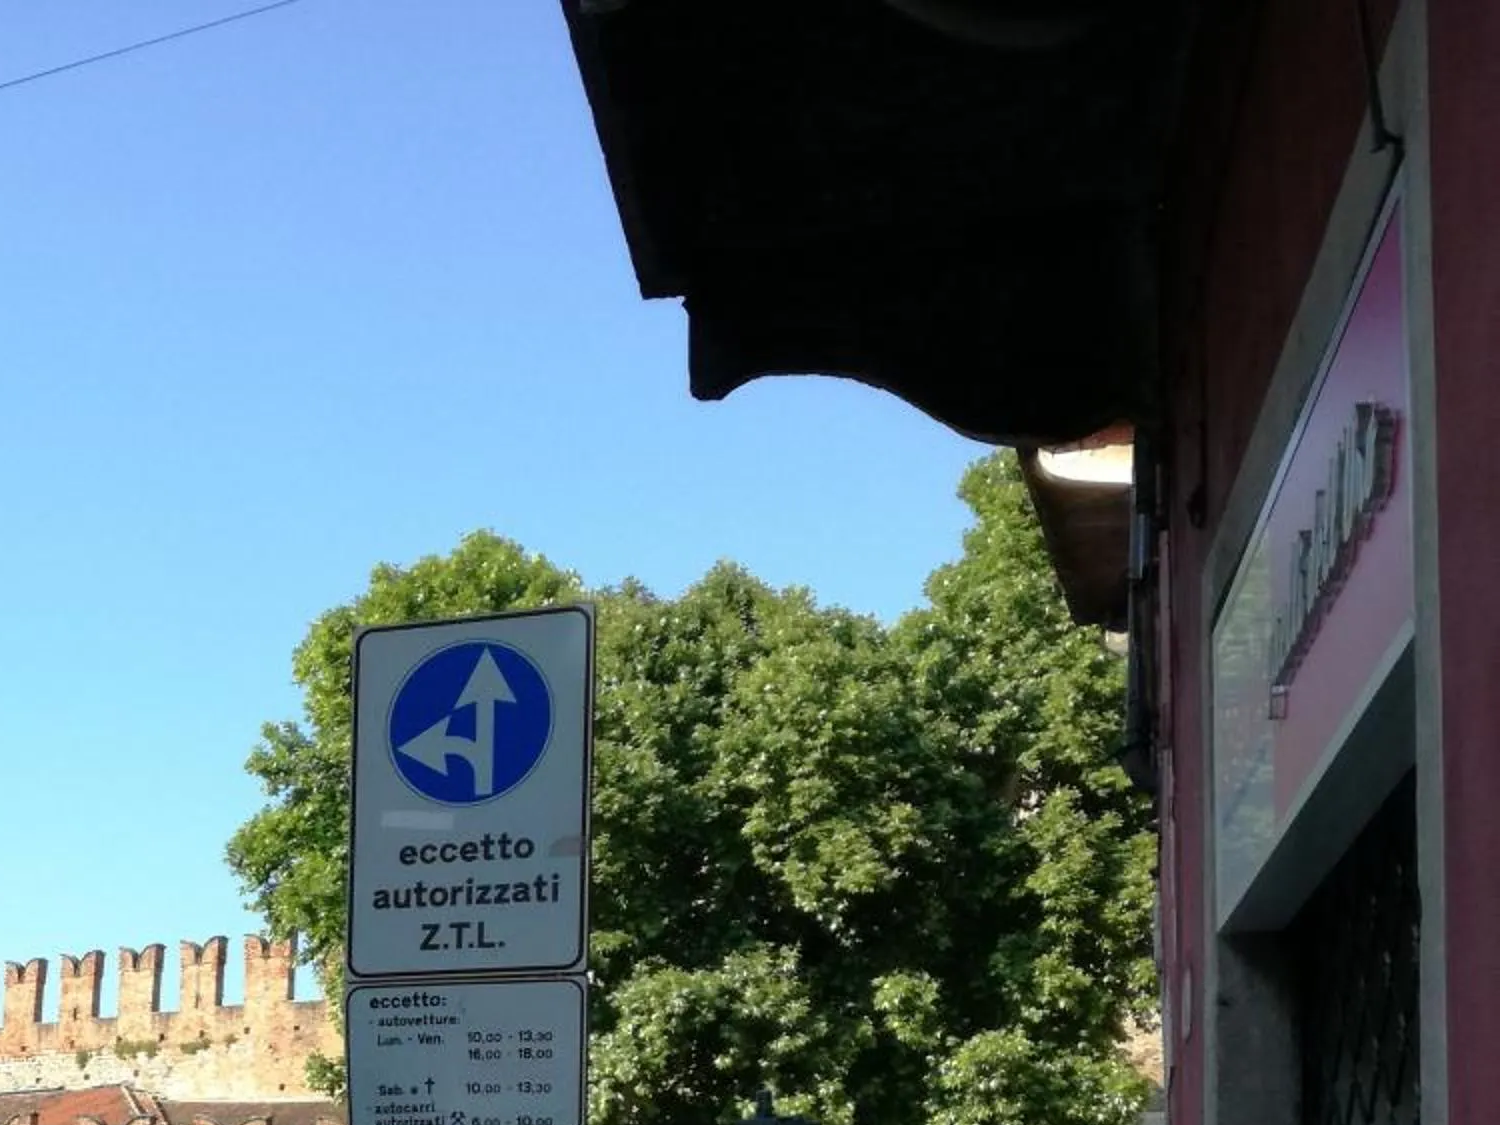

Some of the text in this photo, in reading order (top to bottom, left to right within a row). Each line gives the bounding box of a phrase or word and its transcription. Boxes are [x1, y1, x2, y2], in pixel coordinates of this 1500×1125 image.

[399, 832, 535, 865] eccetto
[372, 873, 560, 909] autorizzati
[419, 921, 506, 950] Z.T.L.
[369, 992, 447, 1009] eccetto:
